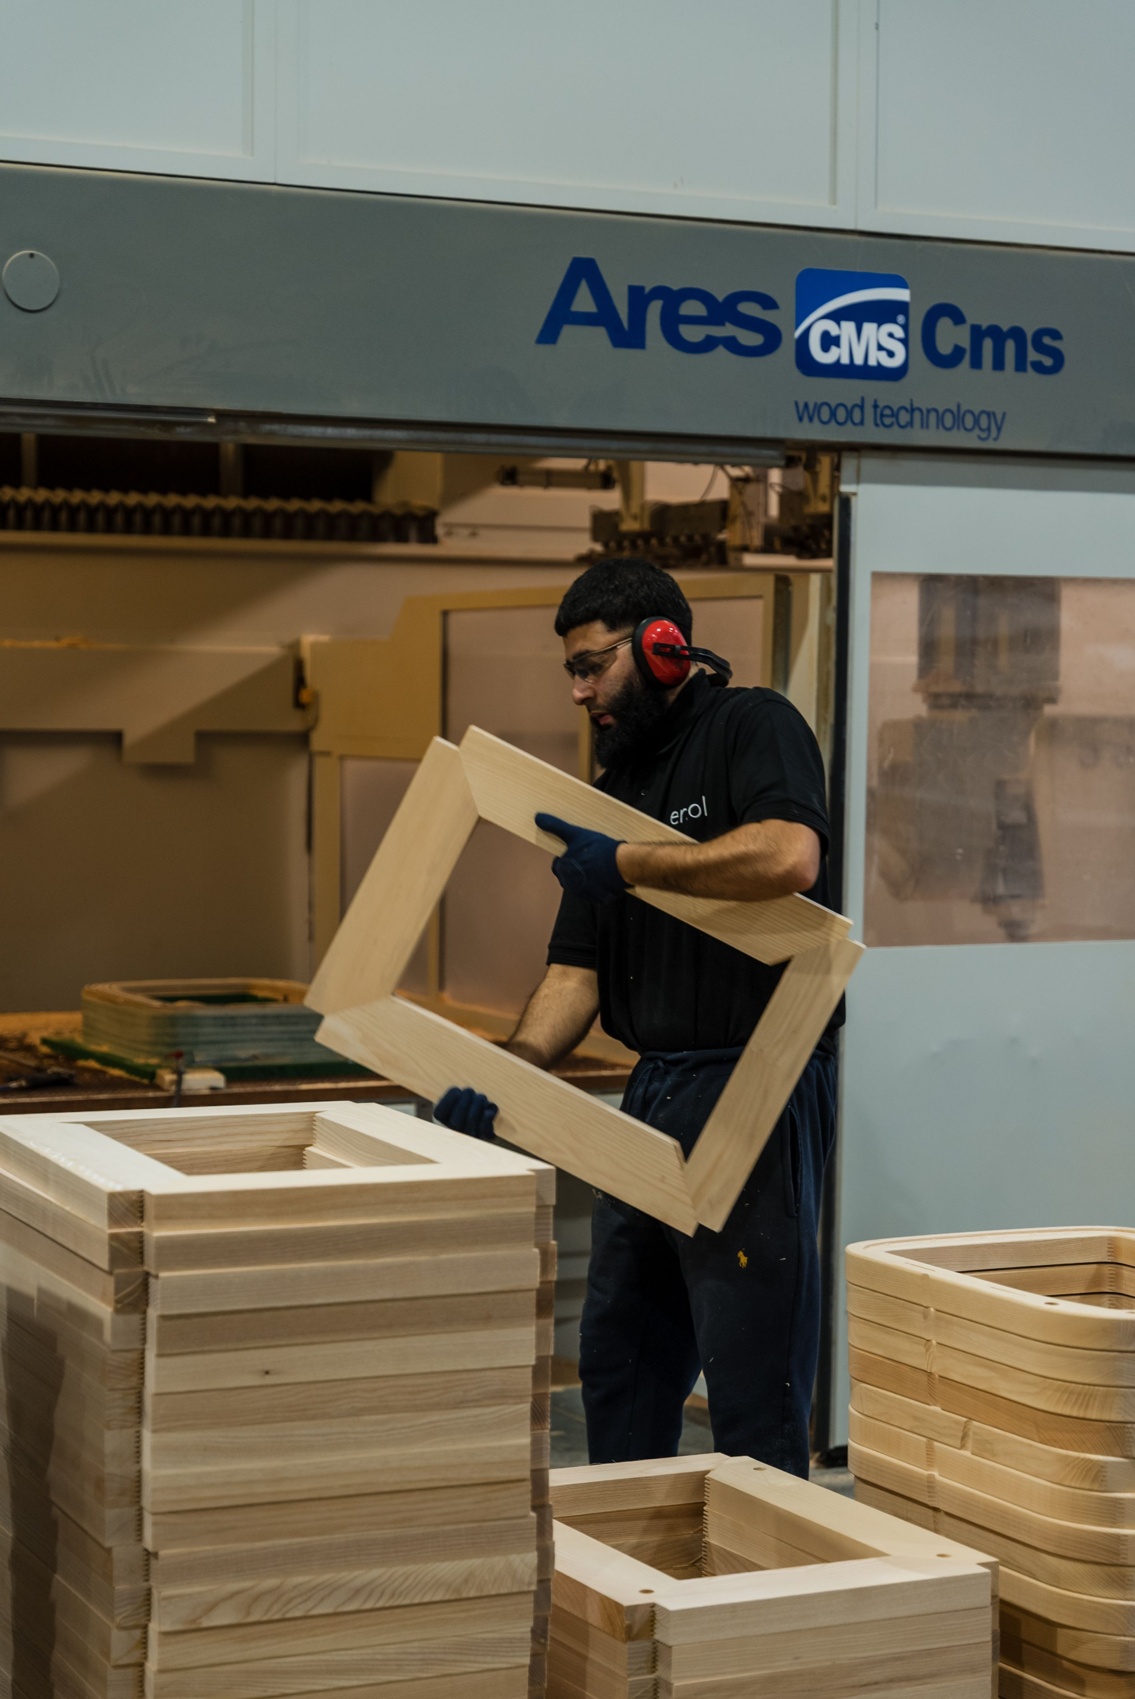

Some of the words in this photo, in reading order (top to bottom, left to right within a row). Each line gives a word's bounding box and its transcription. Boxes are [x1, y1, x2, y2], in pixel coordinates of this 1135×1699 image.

[535, 256, 782, 358] Ares
[808, 318, 906, 368] CMS
[921, 302, 1065, 376] Cms
[794, 396, 864, 427] wood
[872, 399, 1007, 442] technology
[669, 795, 708, 825] erol
